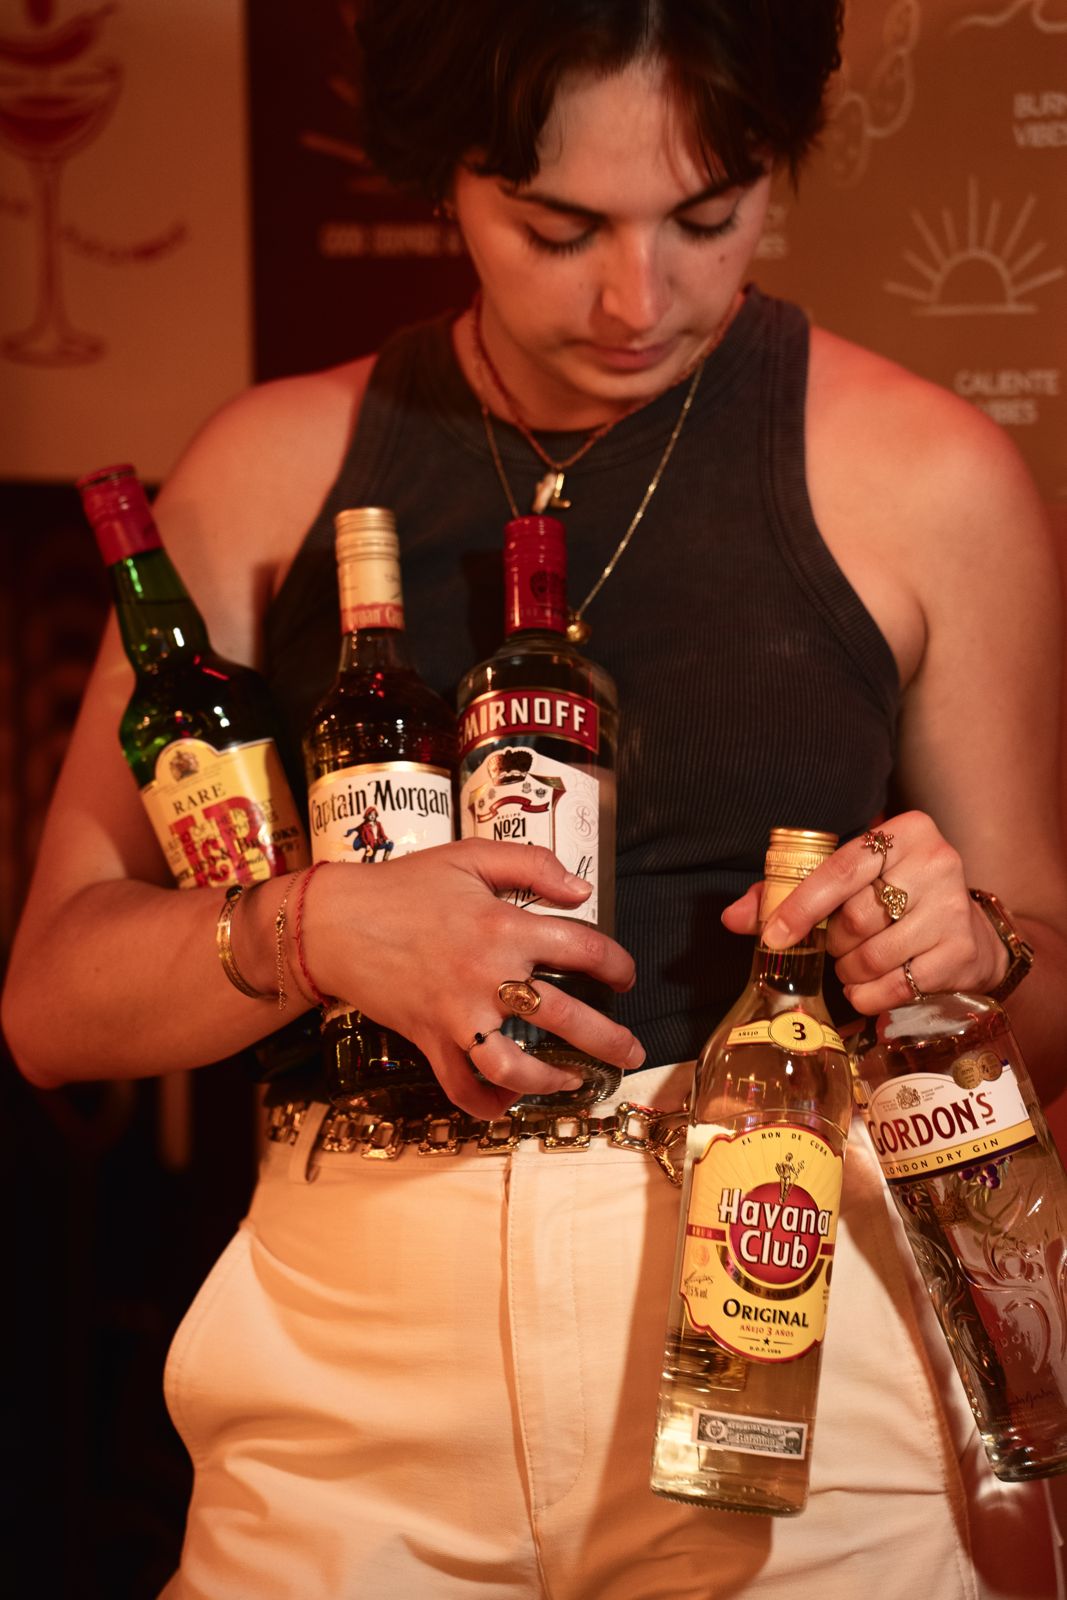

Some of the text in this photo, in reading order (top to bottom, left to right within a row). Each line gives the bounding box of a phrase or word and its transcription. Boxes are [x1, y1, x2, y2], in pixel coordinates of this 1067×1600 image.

[954, 370, 1060, 397] CALIENTE
[172, 782, 227, 815] RARE
[310, 784, 367, 837] Captain
[368, 780, 450, 818] Morgan
[792, 1021, 807, 1041] 3
[867, 1091, 996, 1156] GORDON'S
[741, 1131, 828, 1156] EL RON DE CUBA
[885, 1138, 1000, 1175] LONDON DRY GIN
[718, 1187, 832, 1237] Havana
[739, 1229, 809, 1270] Club
[740, 1324, 794, 1338] AÑEJO 3 AÑOS
